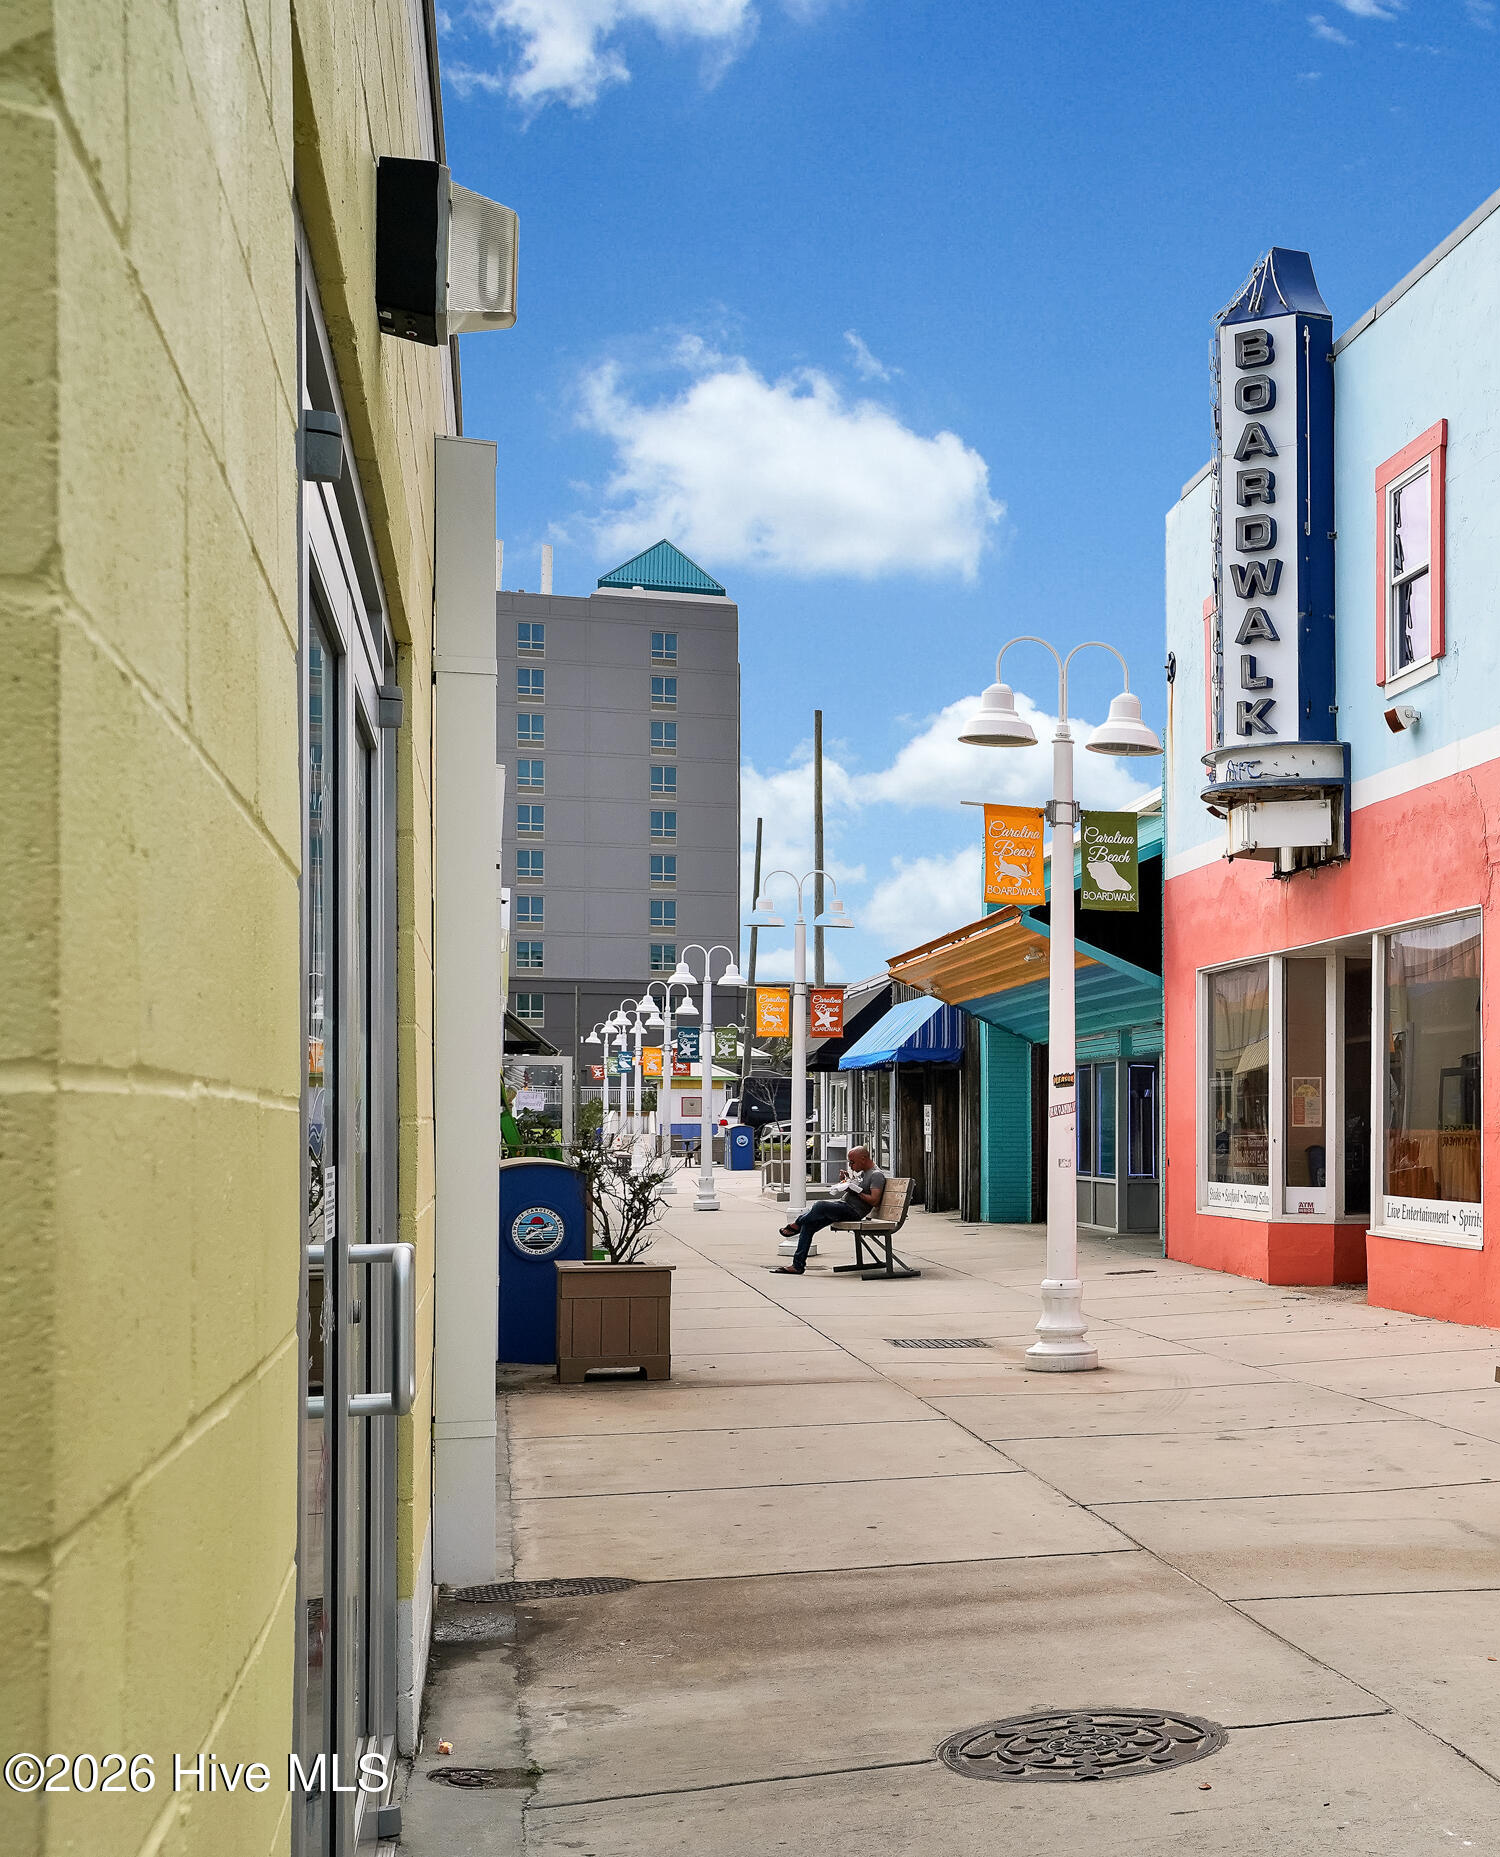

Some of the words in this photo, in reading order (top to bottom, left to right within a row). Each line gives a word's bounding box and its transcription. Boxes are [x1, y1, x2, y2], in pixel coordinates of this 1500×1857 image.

[1229, 328, 1284, 737] BOARDWALK
[989, 820, 1040, 839] Carolina
[1084, 826, 1134, 844] Carolina
[992, 839, 1036, 858] Beach
[1088, 845, 1130, 863] Beach
[987, 885, 1041, 896] BOARDWALK
[1083, 891, 1136, 901] BOARDWALK
[527, 1208, 556, 1218] CAROLINA
[1387, 1202, 1400, 1219] Live
[1402, 1204, 1449, 1224] Entertainment
[1459, 1209, 1482, 1232] Spirits
